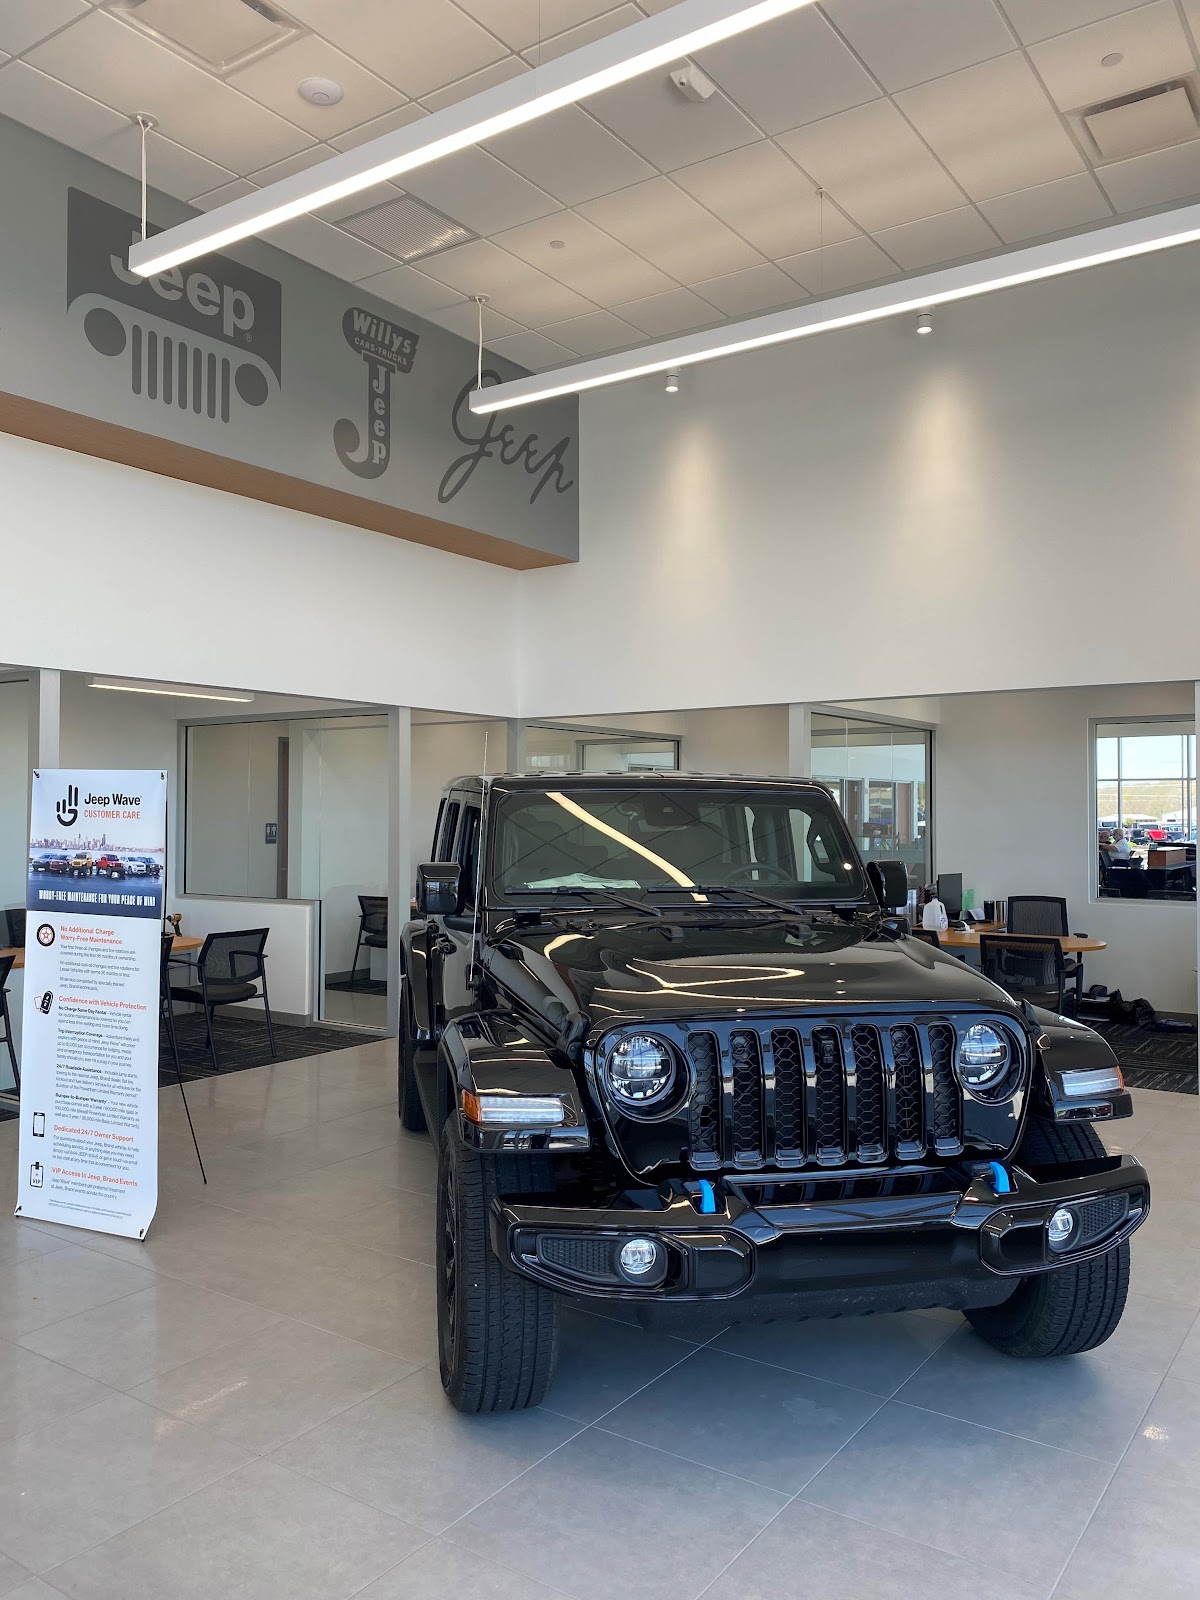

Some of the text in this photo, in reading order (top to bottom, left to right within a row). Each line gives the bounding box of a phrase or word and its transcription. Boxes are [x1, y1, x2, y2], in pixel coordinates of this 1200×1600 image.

[353, 309, 411, 354] Willys
[372, 364, 387, 464] Jeep
[438, 369, 573, 504] Jeep
[84, 793, 110, 807] Jeep
[84, 809, 140, 819] CUSTOMER CARE
[39, 889, 156, 907] WORRY-FREE MAINTENANCE FOR YOUR PEACE OF MIND
[60, 934, 122, 945] Worry-Free Maintenance
[68, 926, 94, 934] Additional
[95, 928, 114, 936] Charge
[59, 996, 88, 1005] Confidence
[100, 1000, 119, 1008] Vehicle
[120, 1002, 147, 1011] Protection
[53, 1125, 80, 1135] Dedicated
[94, 1131, 111, 1139] Owner
[112, 1134, 134, 1142] Support
[52, 1166, 62, 1174] VIP
[61, 1168, 81, 1178] Access
[102, 1175, 118, 1184] Brand
[119, 1178, 138, 1187] Events
